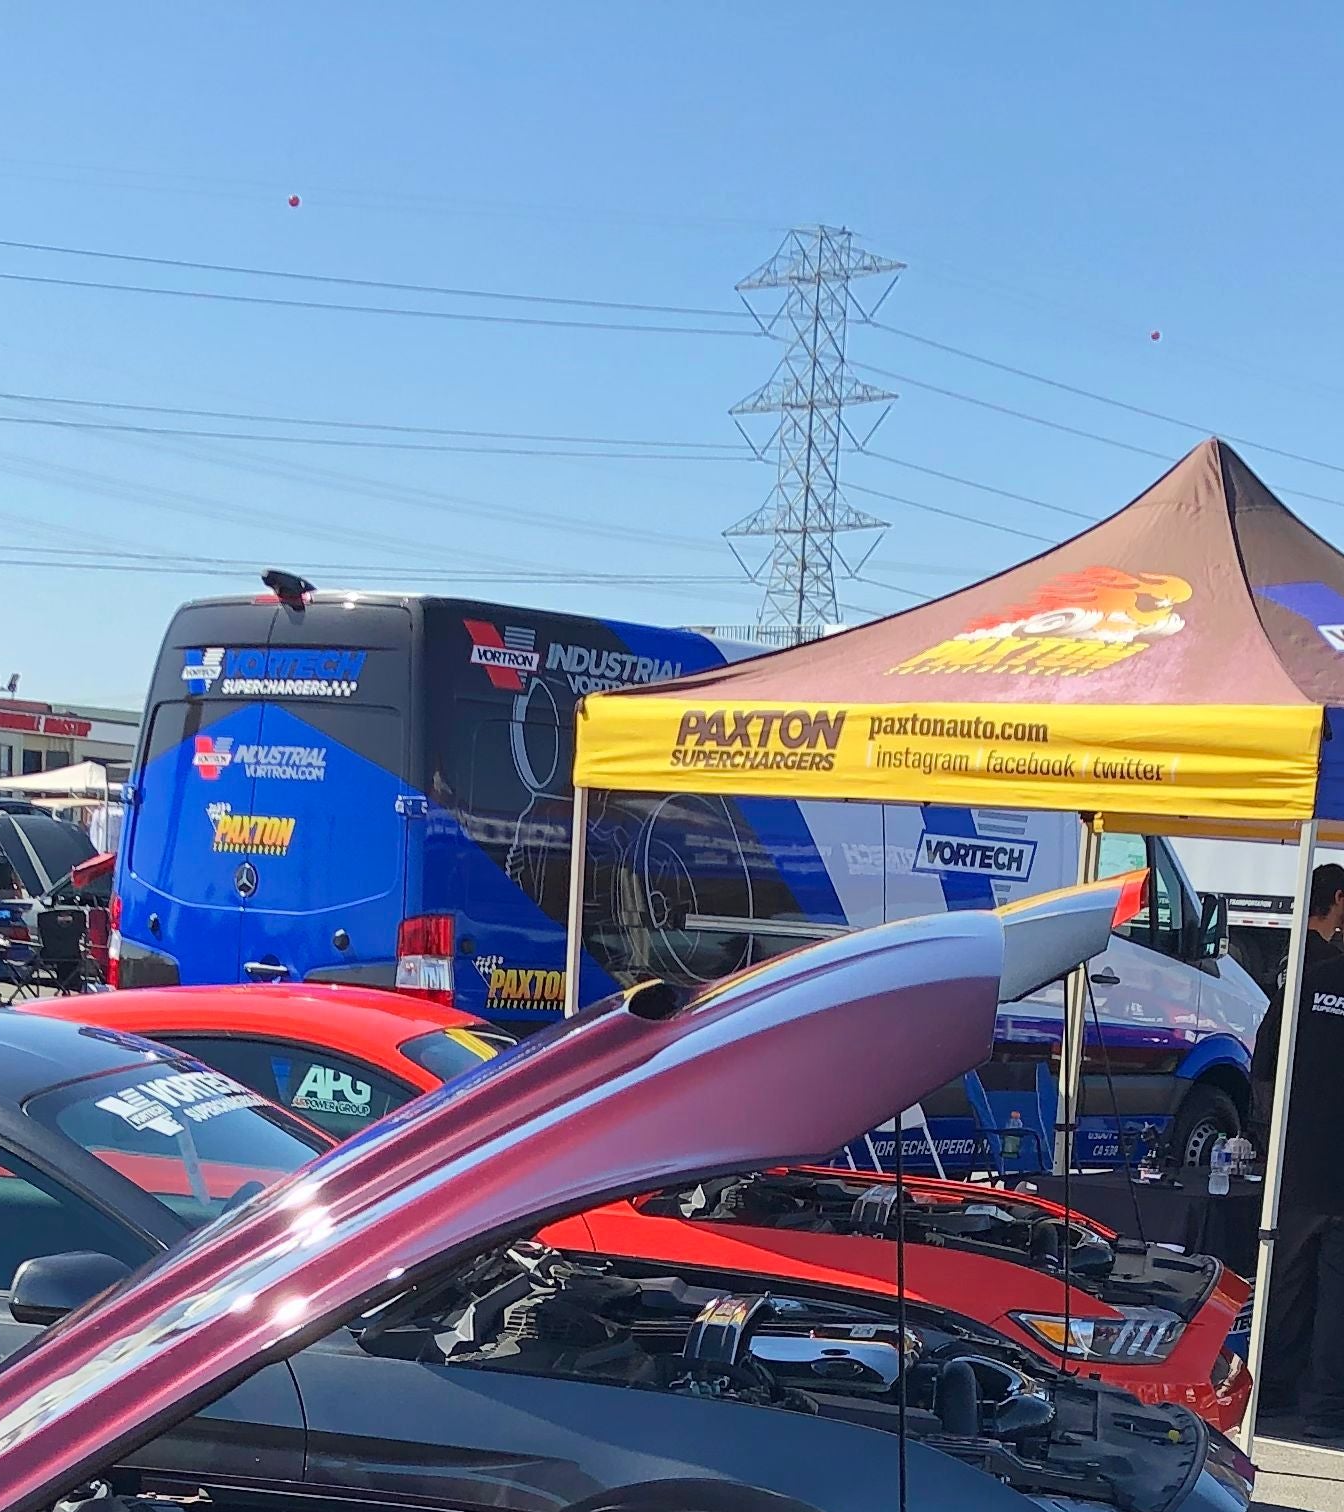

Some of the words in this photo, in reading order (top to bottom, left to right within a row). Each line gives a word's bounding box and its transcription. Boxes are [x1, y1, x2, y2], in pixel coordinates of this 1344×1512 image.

[225, 650, 368, 680] VORTECH
[476, 649, 534, 667] VORTRON
[221, 678, 327, 696] SUPERCHARGERS
[675, 710, 847, 750] PAXTON
[868, 713, 1048, 743] paxtonauto.com
[234, 745, 327, 767] INDUSTRIAL
[670, 749, 836, 772] SUPERCHARGERS
[876, 744, 969, 775] instagram
[986, 750, 1076, 778] facebook
[1092, 756, 1164, 781] twitter
[245, 765, 325, 781] VORTRON.COM
[214, 814, 296, 846] PAXTON
[925, 839, 1025, 872] VORTECH
[486, 999, 564, 1010] SUPERCHARGER
[298, 1065, 372, 1108] APG
[338, 1098, 371, 1116] GROUP
